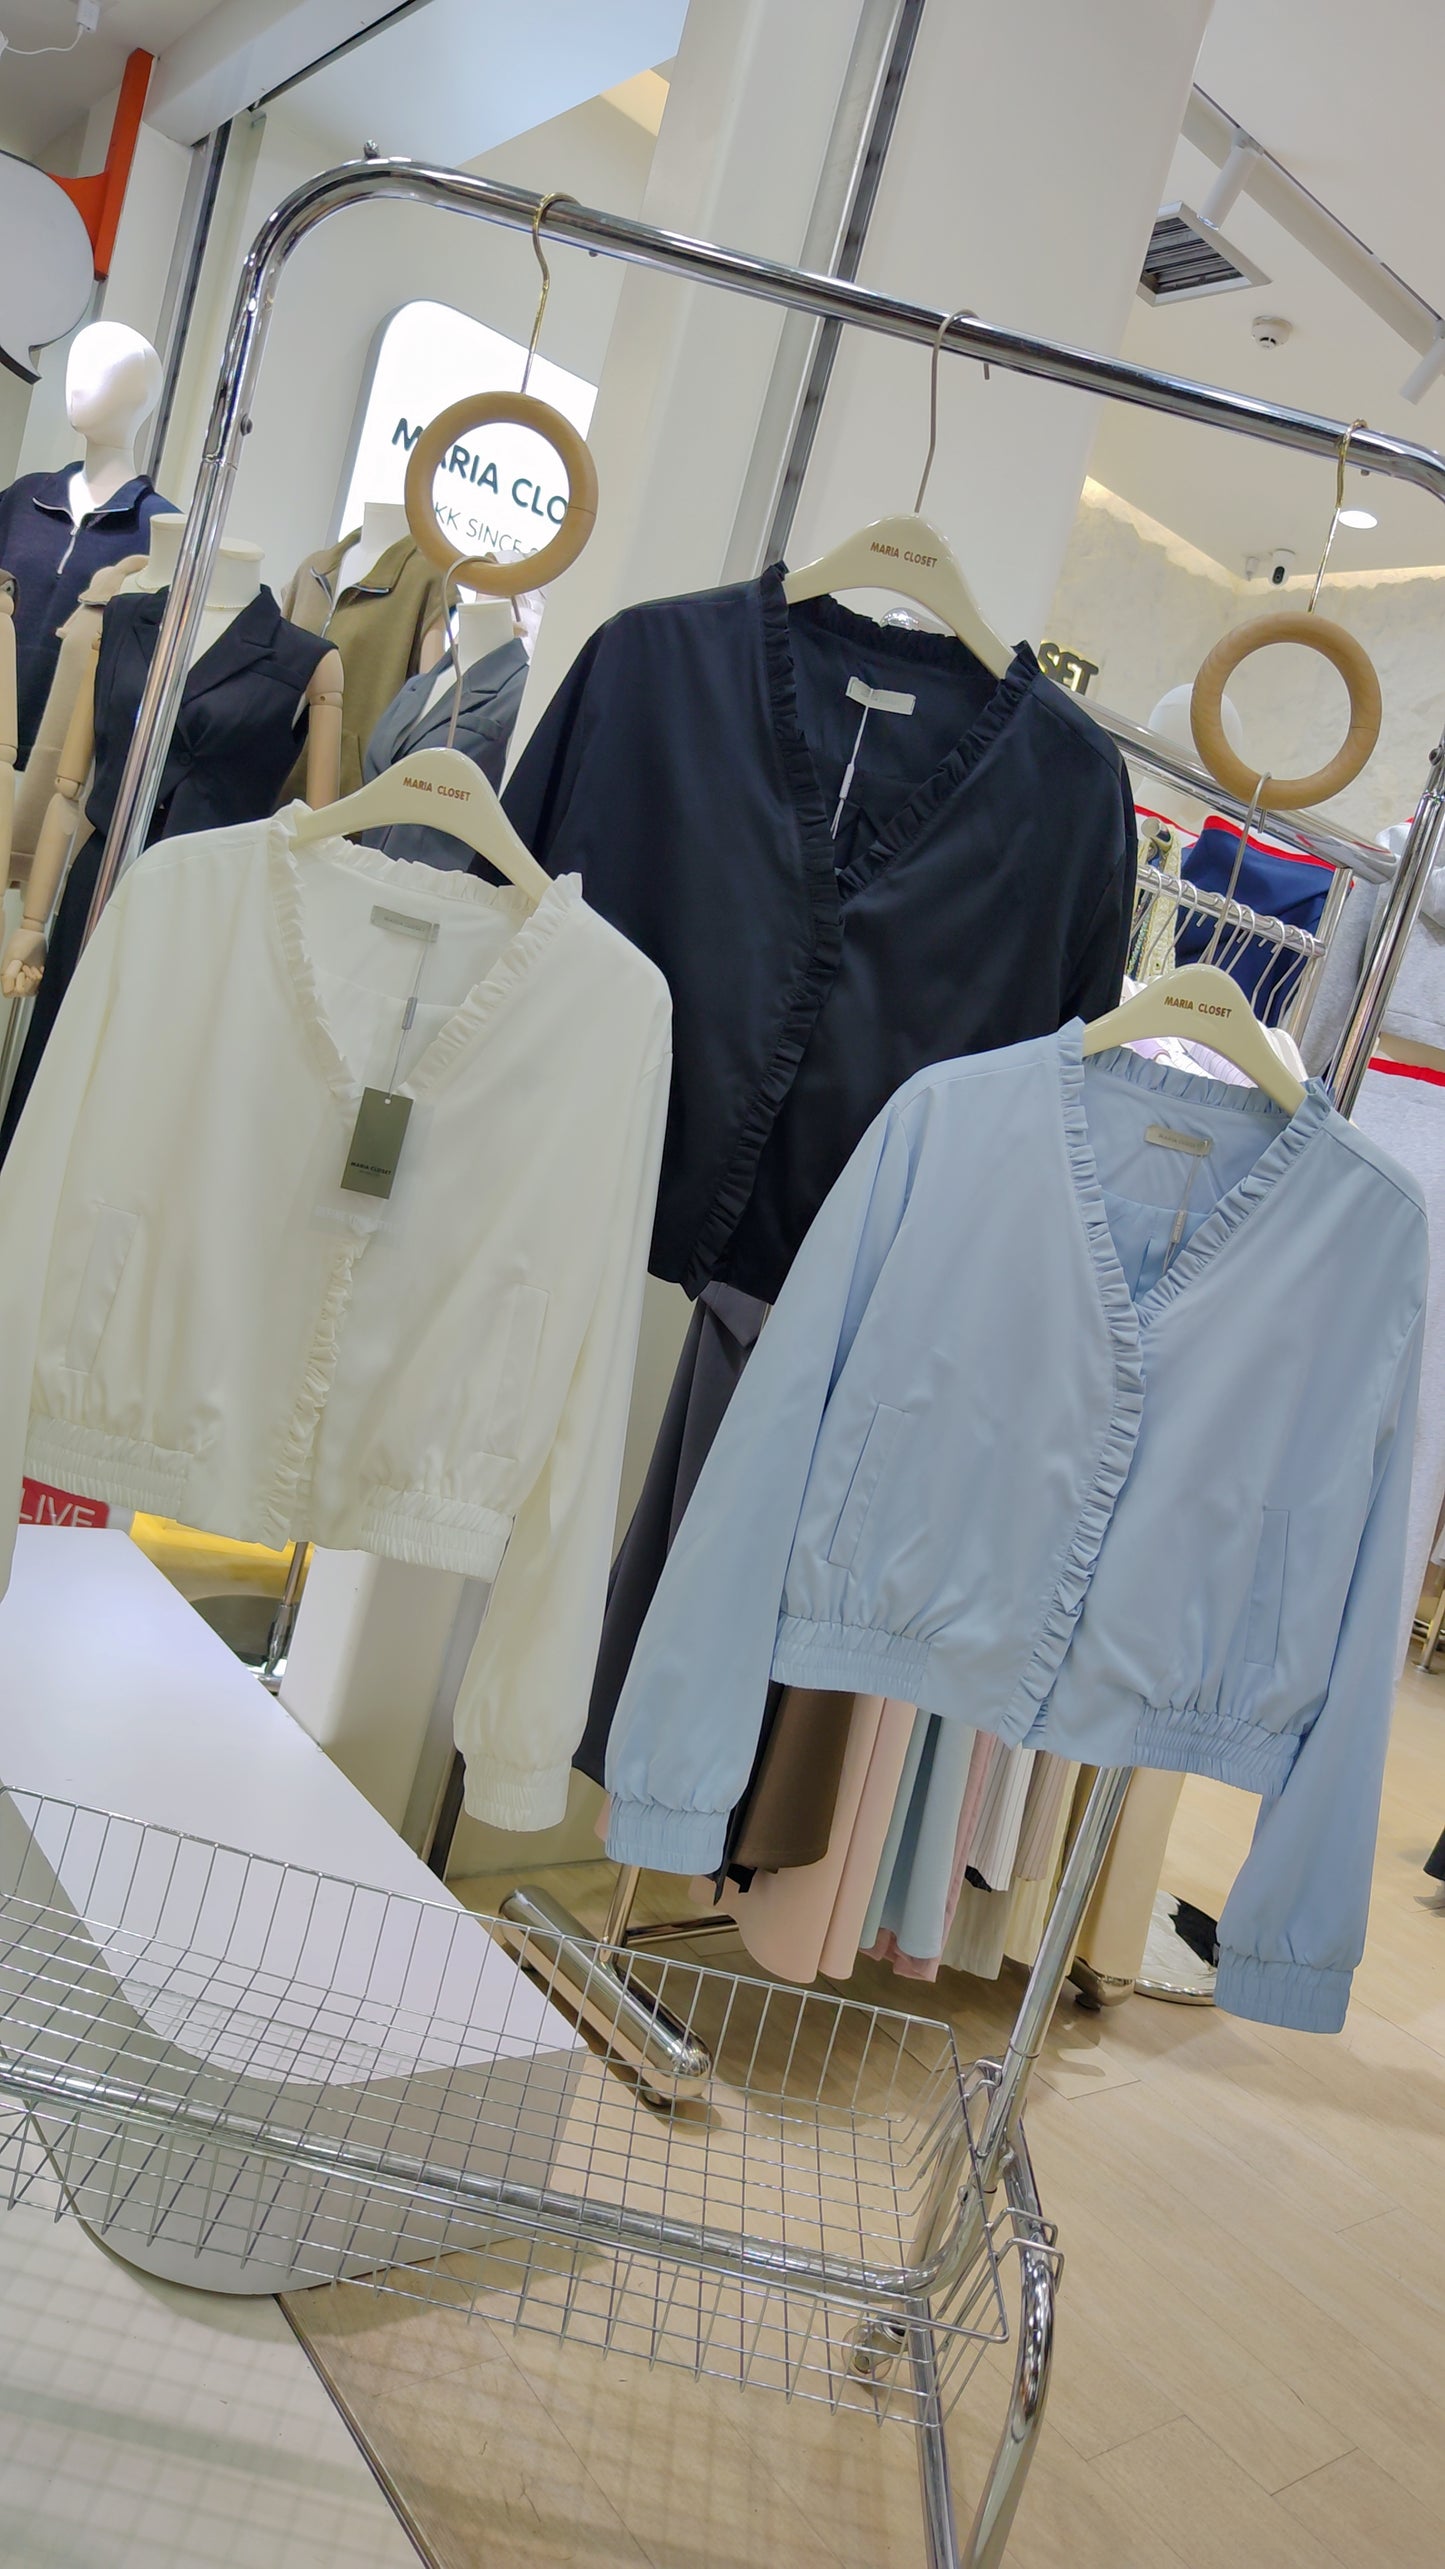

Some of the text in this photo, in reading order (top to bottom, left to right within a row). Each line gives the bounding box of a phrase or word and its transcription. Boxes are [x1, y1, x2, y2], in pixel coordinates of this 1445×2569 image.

[391, 417, 499, 495] MRIA
[869, 541, 938, 568] MARIA CLOSET
[402, 776, 471, 802] MARIA CLOSET
[1163, 995, 1233, 1019] MARIA CLOSET
[20, 1487, 96, 1527] LIVE
